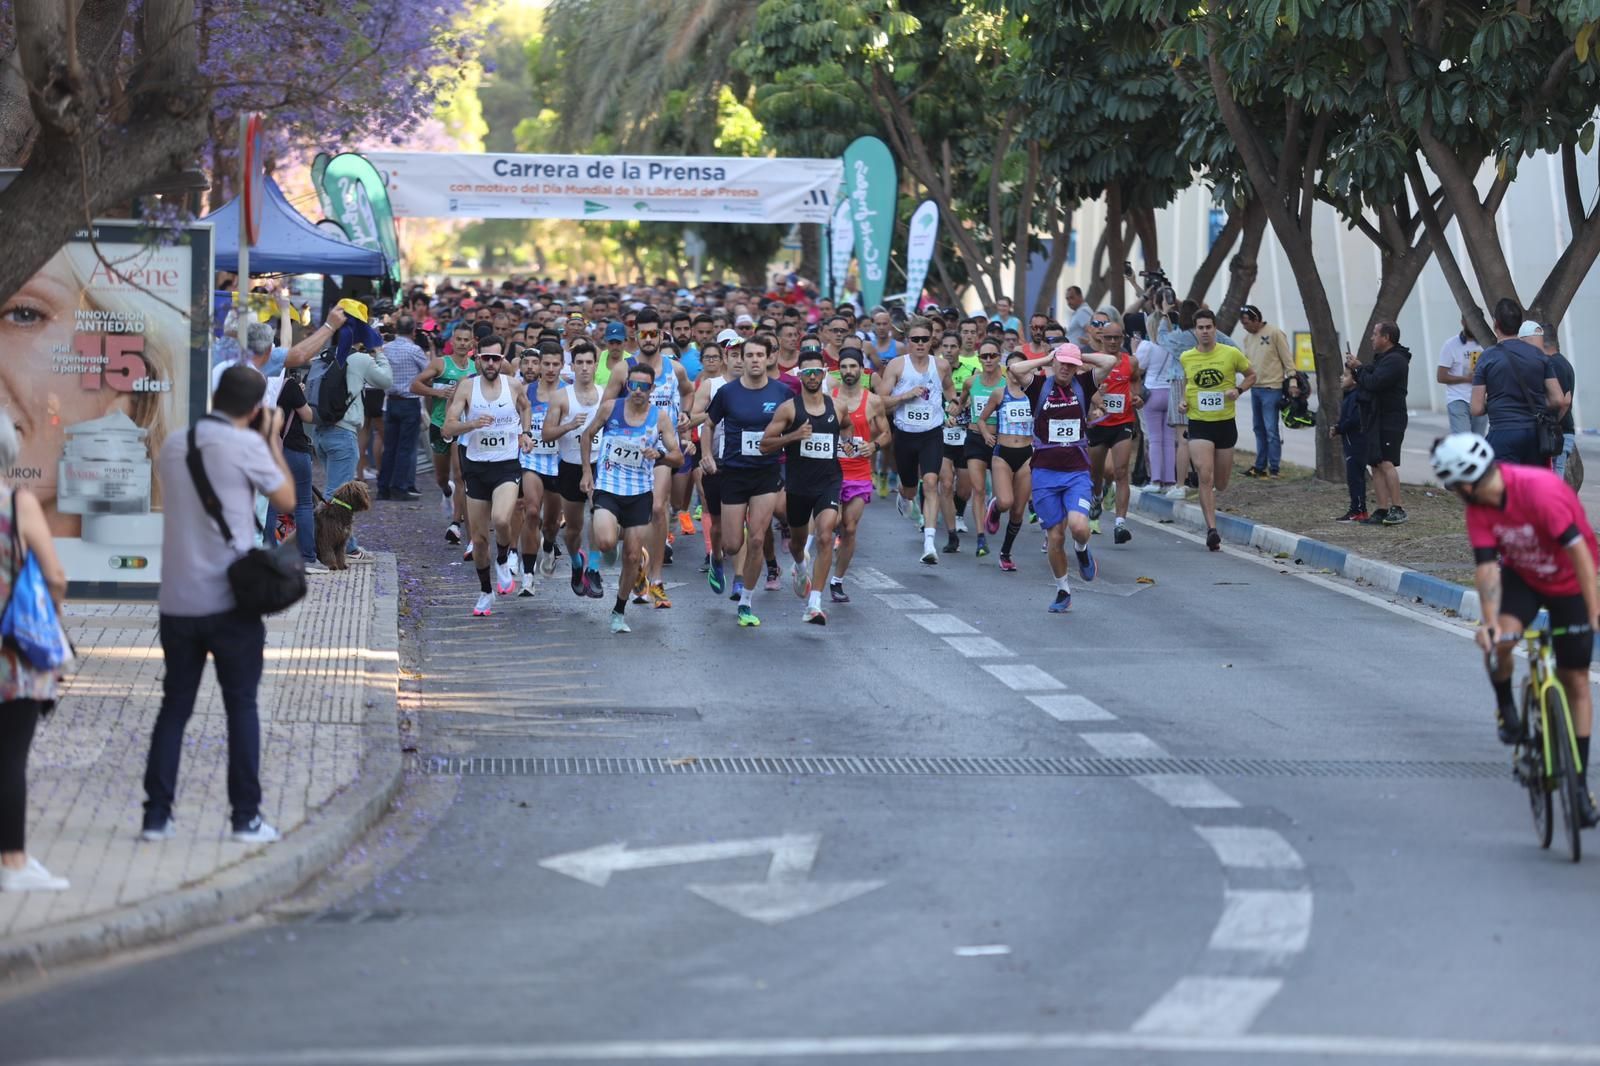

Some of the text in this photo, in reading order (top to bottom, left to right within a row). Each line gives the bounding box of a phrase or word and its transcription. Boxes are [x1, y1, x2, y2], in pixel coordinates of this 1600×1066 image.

[493, 159, 726, 181] Carrera de la Prensa
[449, 184, 472, 192] con
[474, 184, 518, 193] motivo
[521, 184, 540, 194] del
[565, 184, 612, 195] Mundial
[615, 185, 630, 196] de
[633, 186, 644, 196] la
[647, 186, 698, 197] Libertad
[700, 187, 716, 197] de
[718, 187, 759, 197] Prensa
[74, 321, 145, 333] ANTIEDAD
[52, 344, 71, 353] Piel
[52, 355, 109, 365] regenerada
[74, 334, 147, 392] 15
[61, 363, 88, 375] partir
[89, 364, 102, 373] de
[132, 376, 171, 392] días
[1200, 397, 1222, 406] 432
[907, 411, 930, 421] 693
[1010, 408, 1032, 417] 665
[947, 432, 961, 441] 59
[1057, 427, 1074, 437] 28
[480, 437, 505, 447] 401
[804, 441, 831, 452] 668
[613, 447, 640, 460] 471
